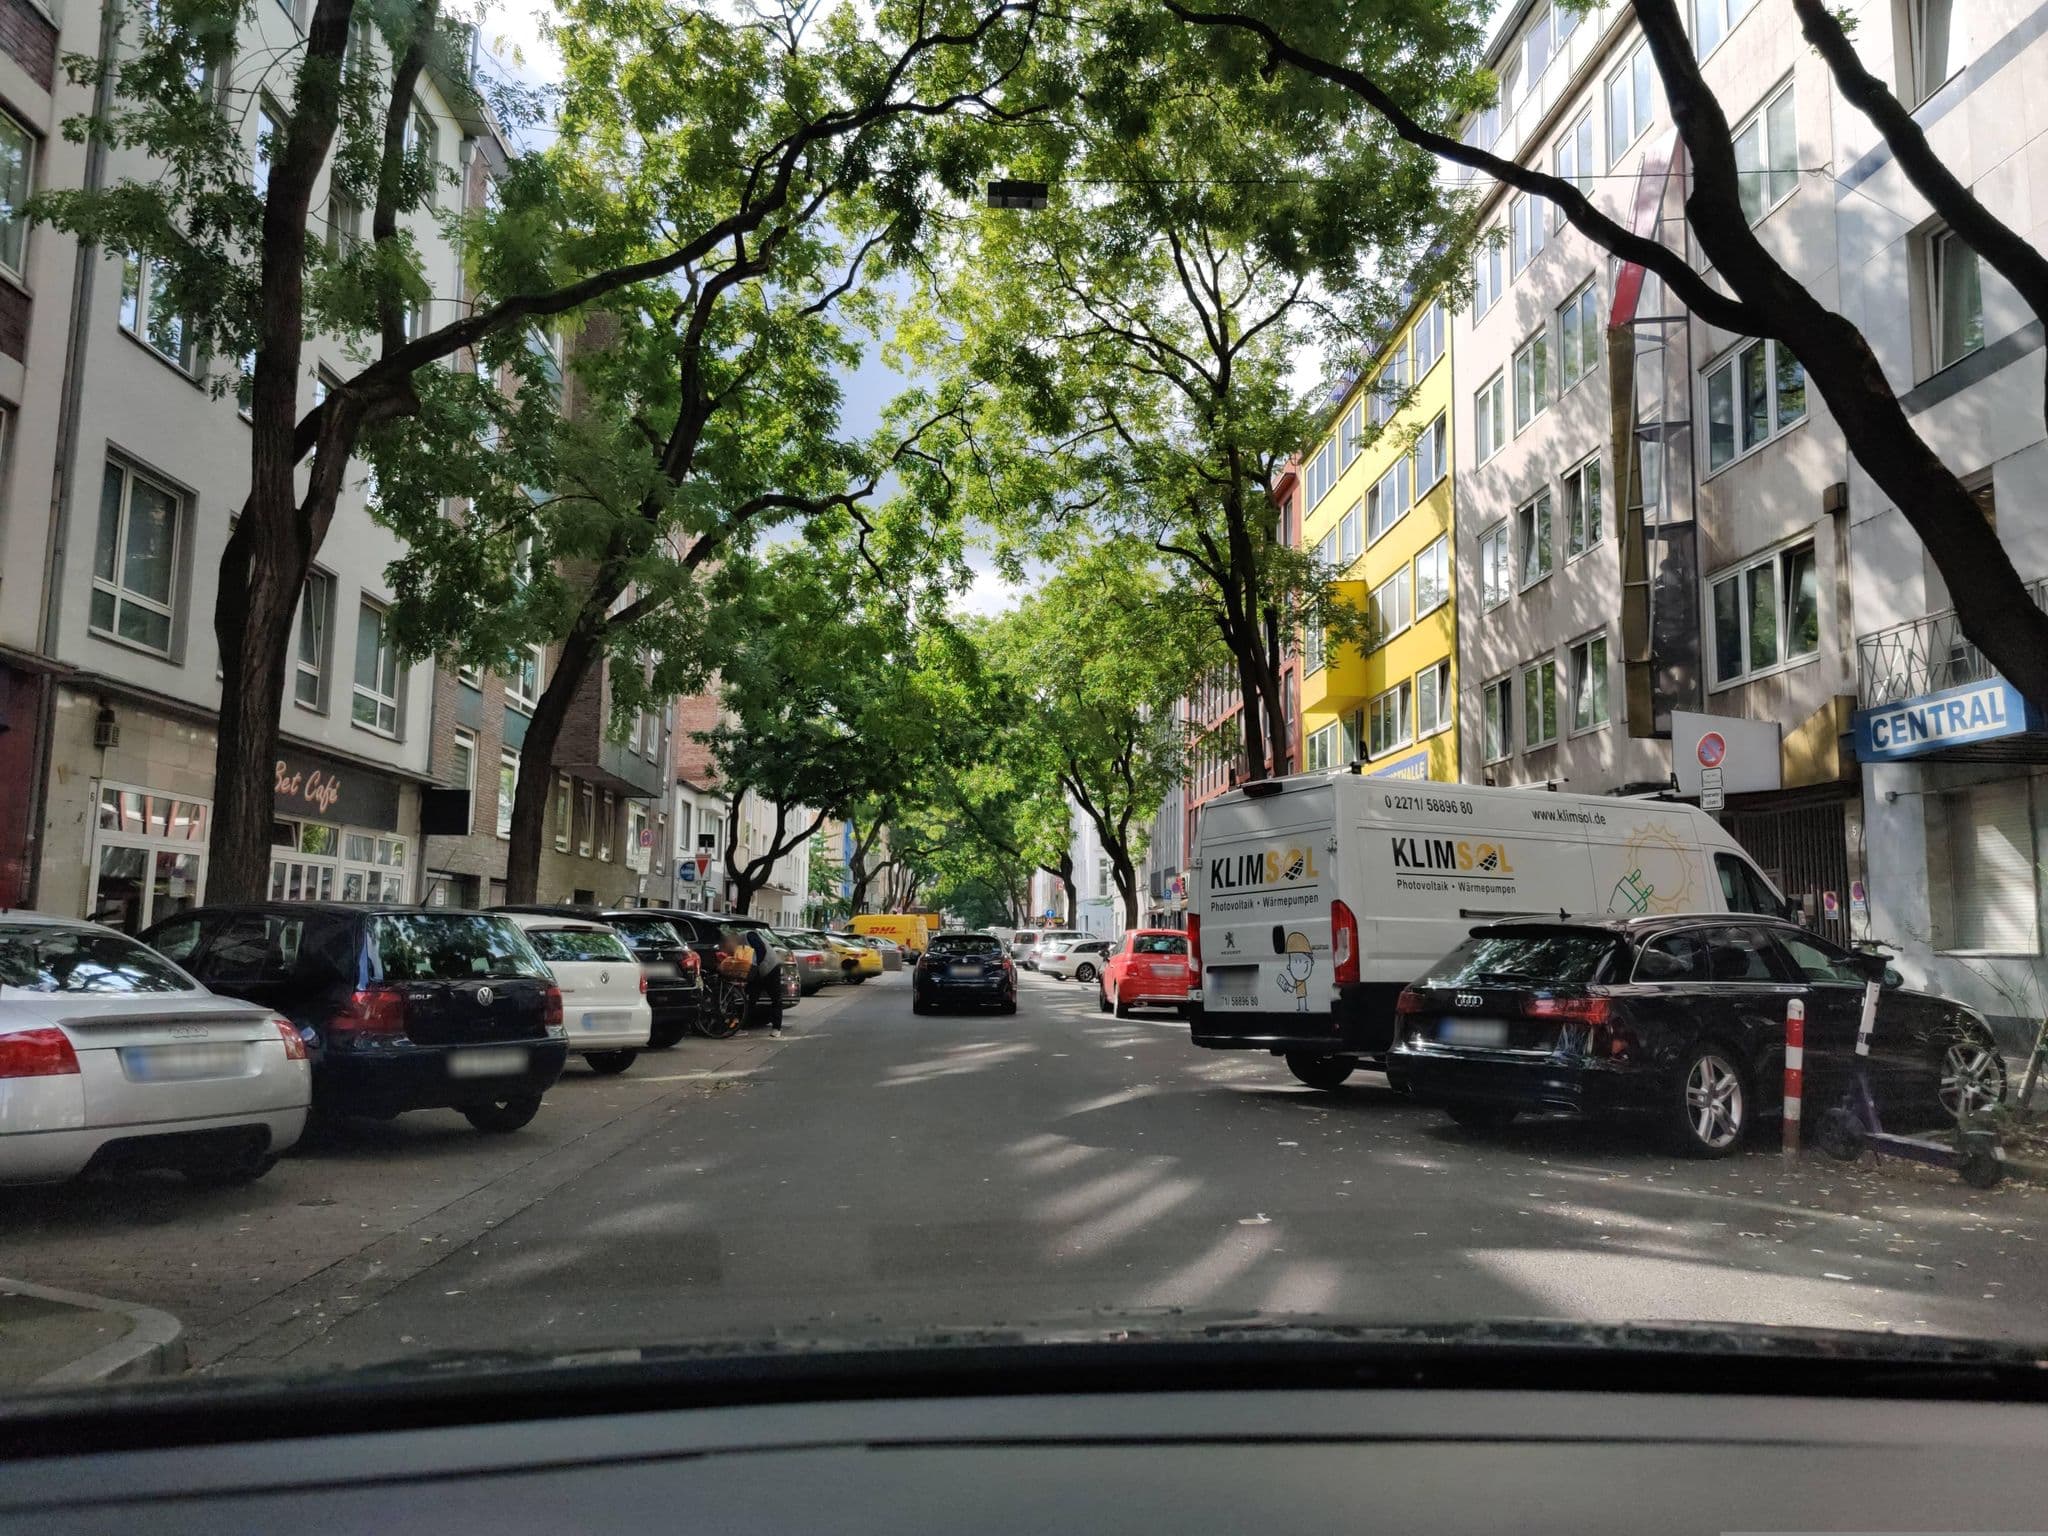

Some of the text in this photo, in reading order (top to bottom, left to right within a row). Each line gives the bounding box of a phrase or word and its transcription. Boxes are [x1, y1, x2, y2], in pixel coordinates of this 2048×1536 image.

[1872, 691, 2005, 748] CENTRAL
[304, 770, 341, 813] Café
[1384, 795, 1392, 809] 0
[1426, 799, 1458, 813] 58896
[1460, 801, 1473, 815] 80
[1531, 808, 1607, 825] www.klimsol.de
[1397, 879, 1516, 896] Photovoltaik Wärmepumpen
[1210, 894, 1319, 912] Photovoltaik Wärmepumpen
[867, 926, 897, 934] DHL
